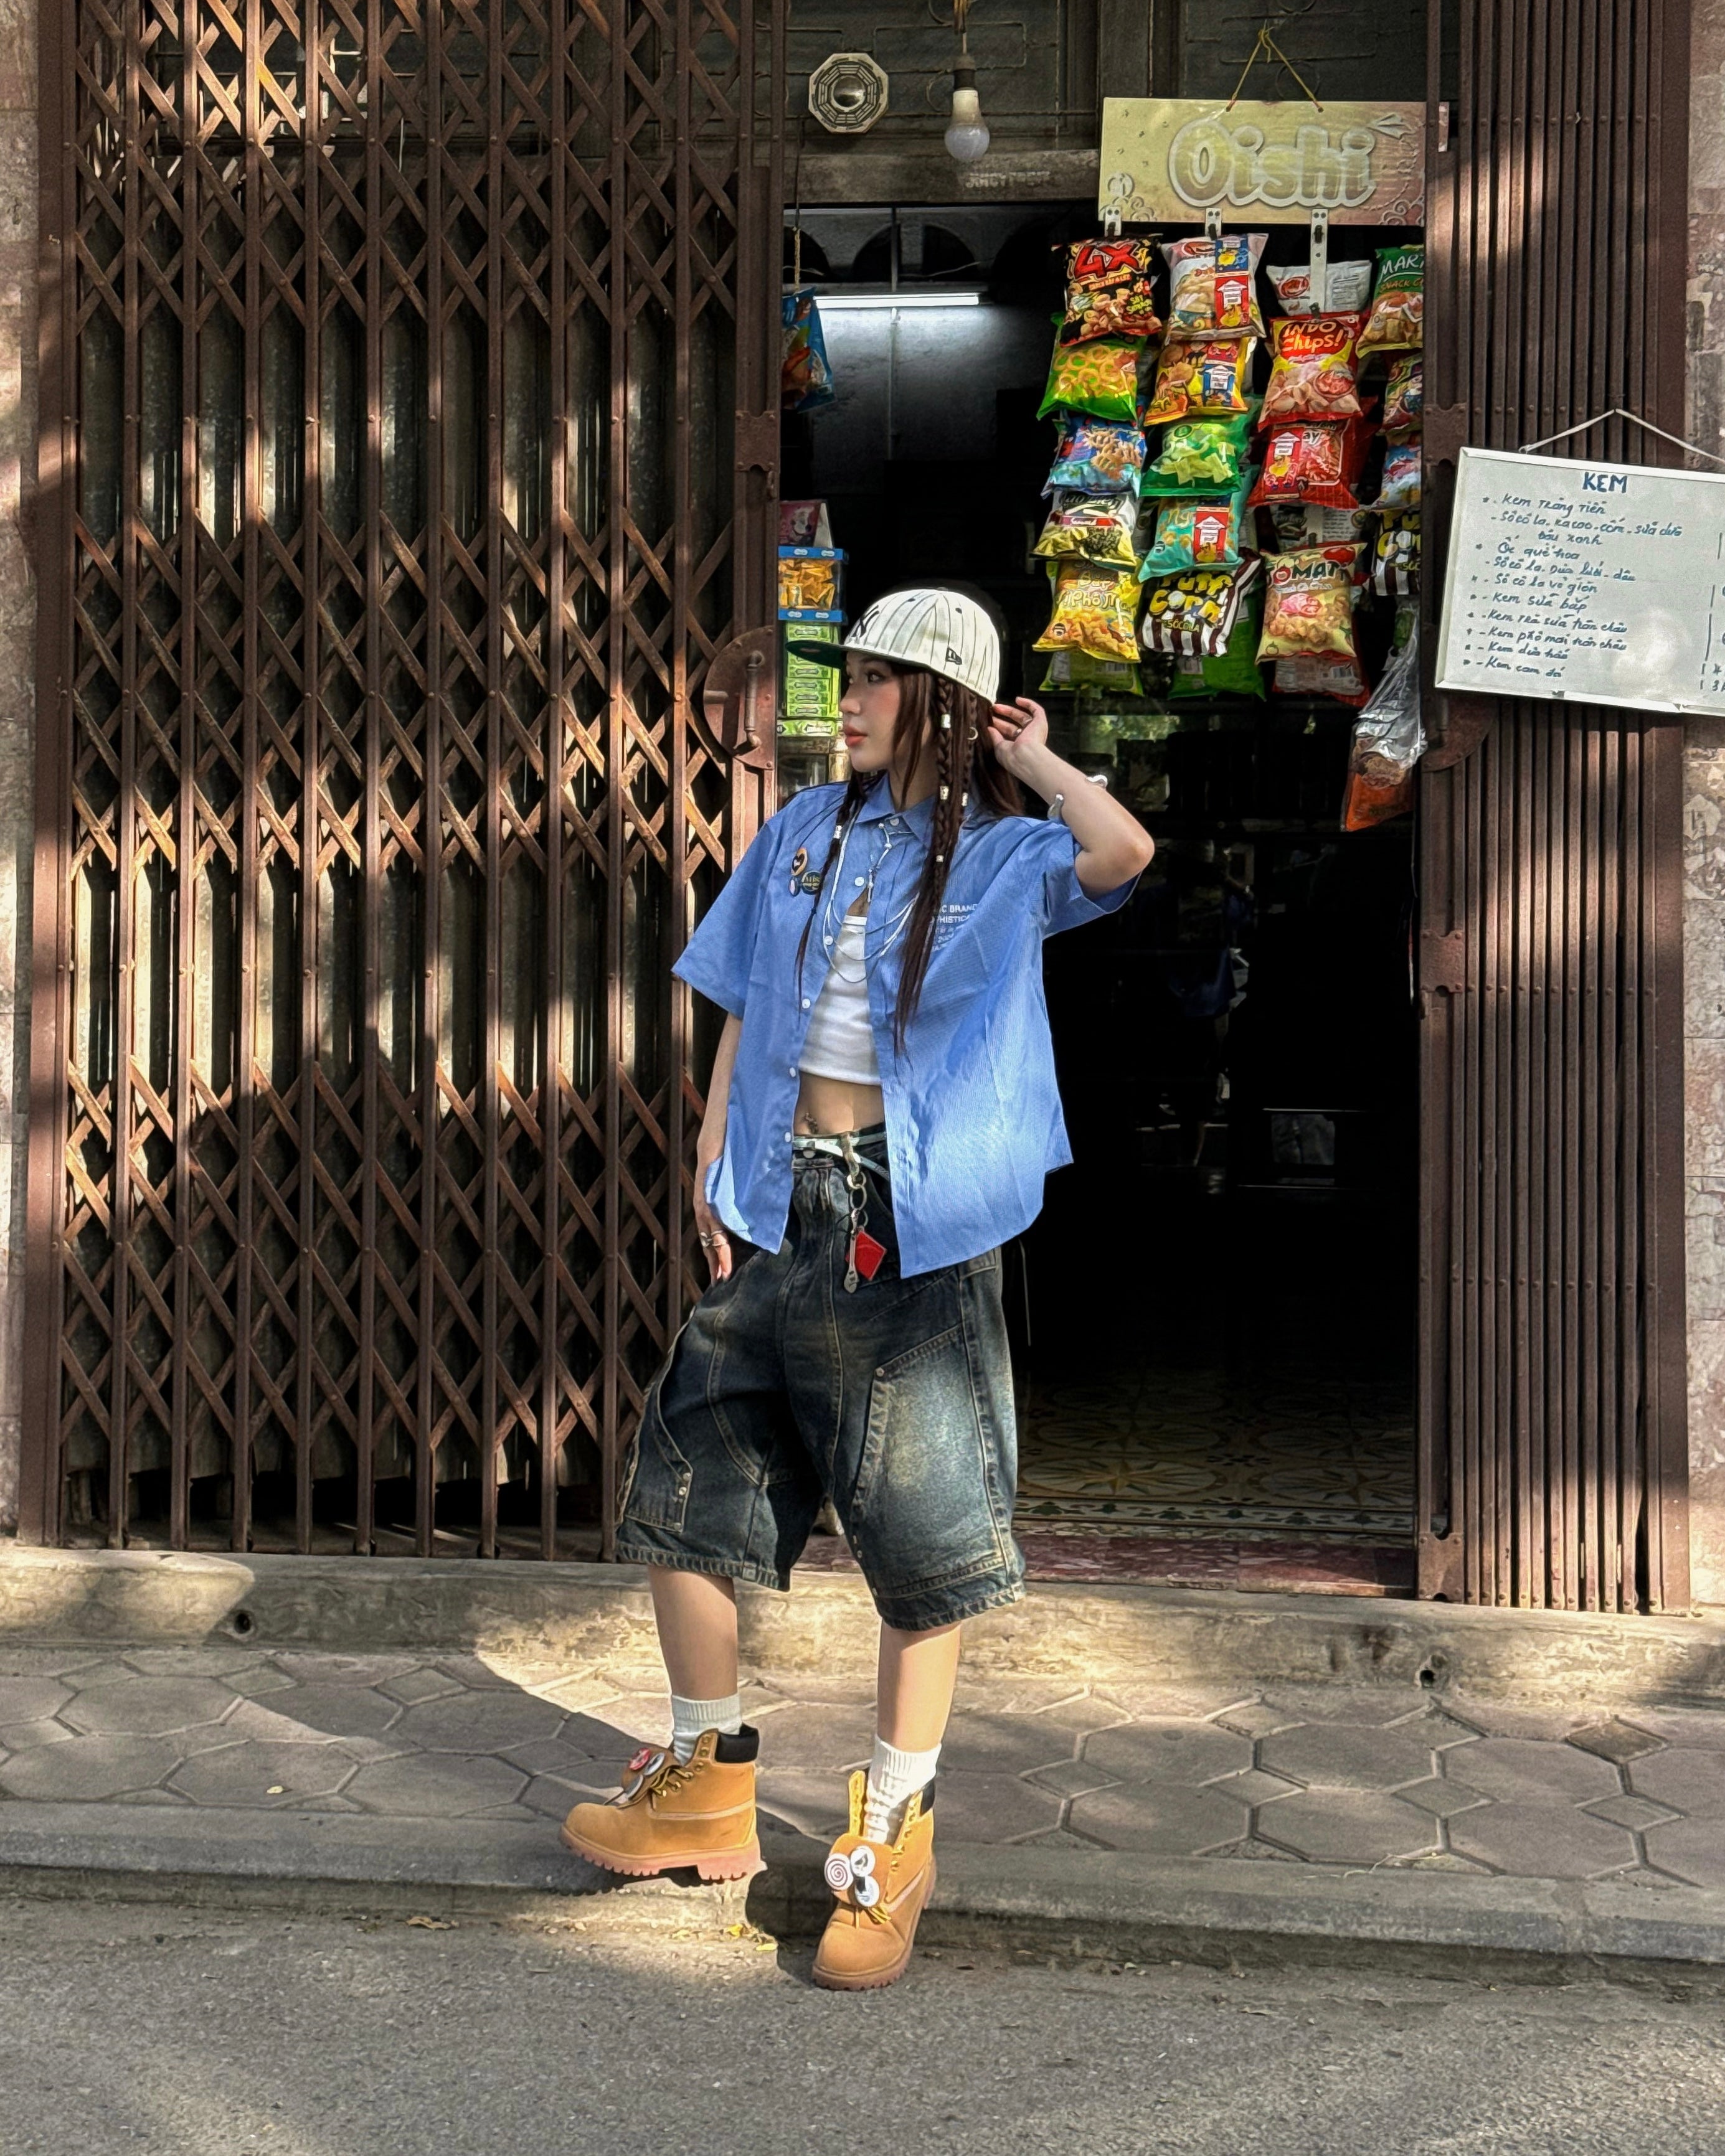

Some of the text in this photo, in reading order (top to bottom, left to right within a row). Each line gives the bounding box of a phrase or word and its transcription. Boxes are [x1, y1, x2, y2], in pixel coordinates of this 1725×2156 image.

[1169, 118, 1376, 207] Oishi
[1283, 321, 1337, 337] INDO
[1582, 472, 1628, 493] KEM
[1502, 493, 1531, 507] Kem
[1493, 591, 1520, 603] Kem
[1488, 609, 1514, 621] Kem
[1488, 626, 1514, 638] Kem
[1488, 641, 1513, 652] Kem
[1485, 656, 1511, 670] Kem
